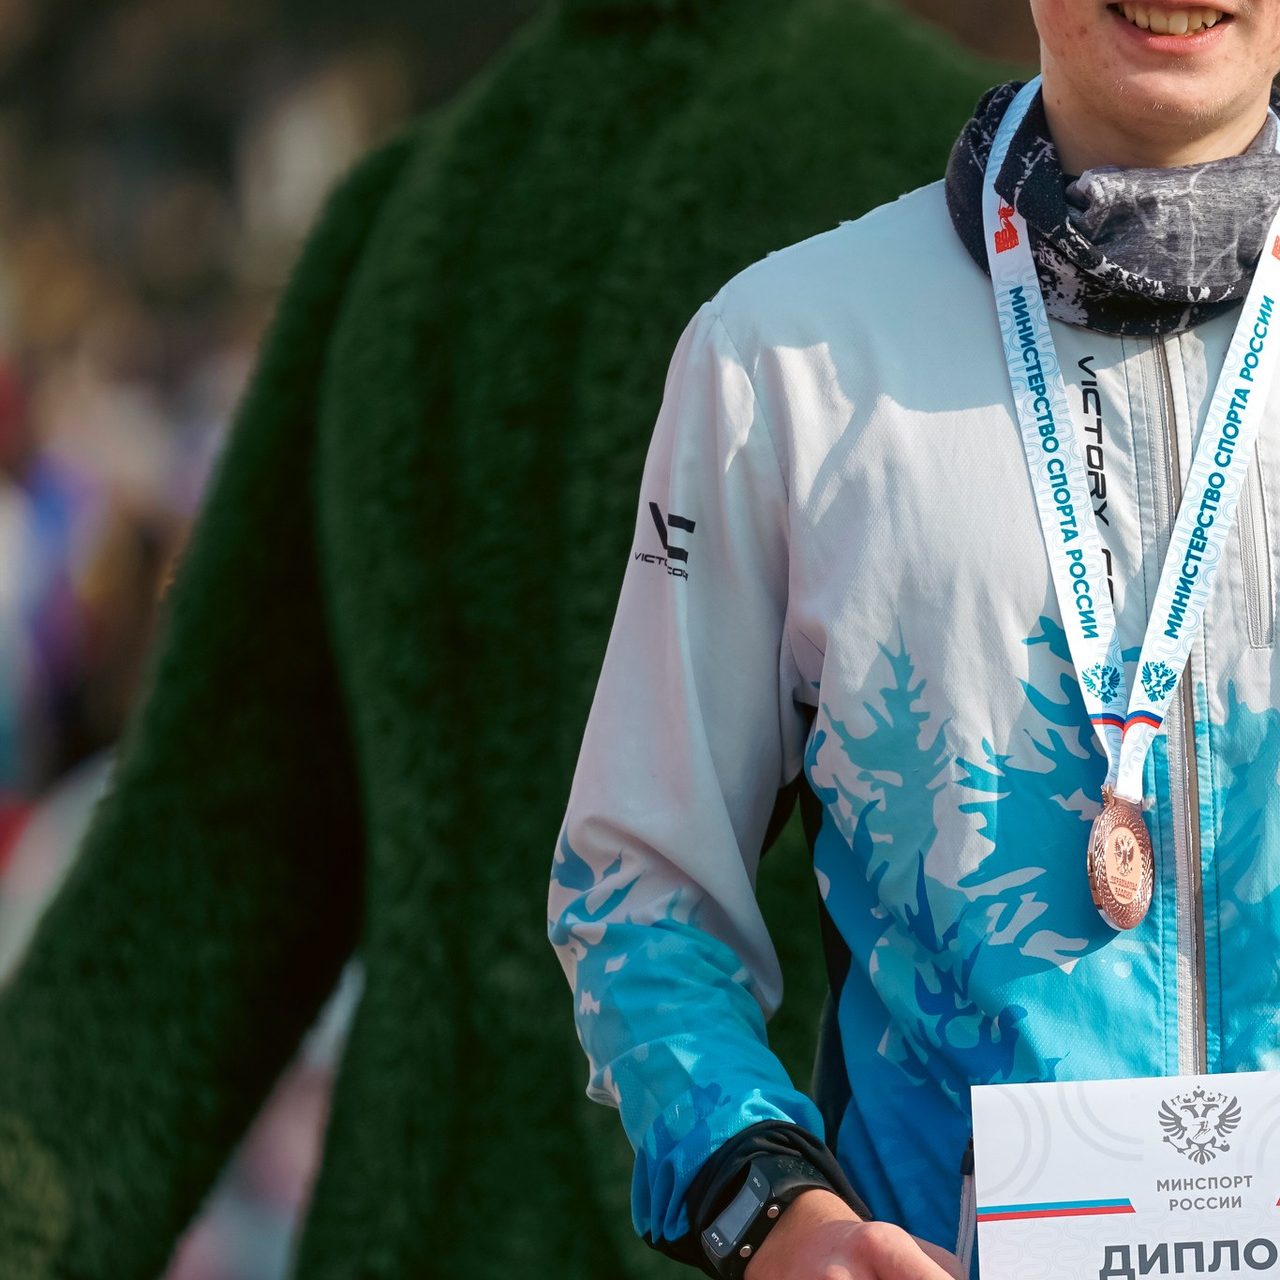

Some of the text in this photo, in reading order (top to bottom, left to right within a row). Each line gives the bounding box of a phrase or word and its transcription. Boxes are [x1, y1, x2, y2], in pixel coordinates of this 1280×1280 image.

[1008, 284, 1100, 639] МИНИСТЕРСТВО СПОРТА РОССИИ
[1077, 355, 1110, 527] VICTORY
[1163, 294, 1275, 640] МИНИСТЕРСТВО СПОРТА РОССИИ
[634, 552, 668, 567] VICT
[1156, 1174, 1253, 1193] МИНСПОРТ
[1169, 1195, 1242, 1212] РОССИИ
